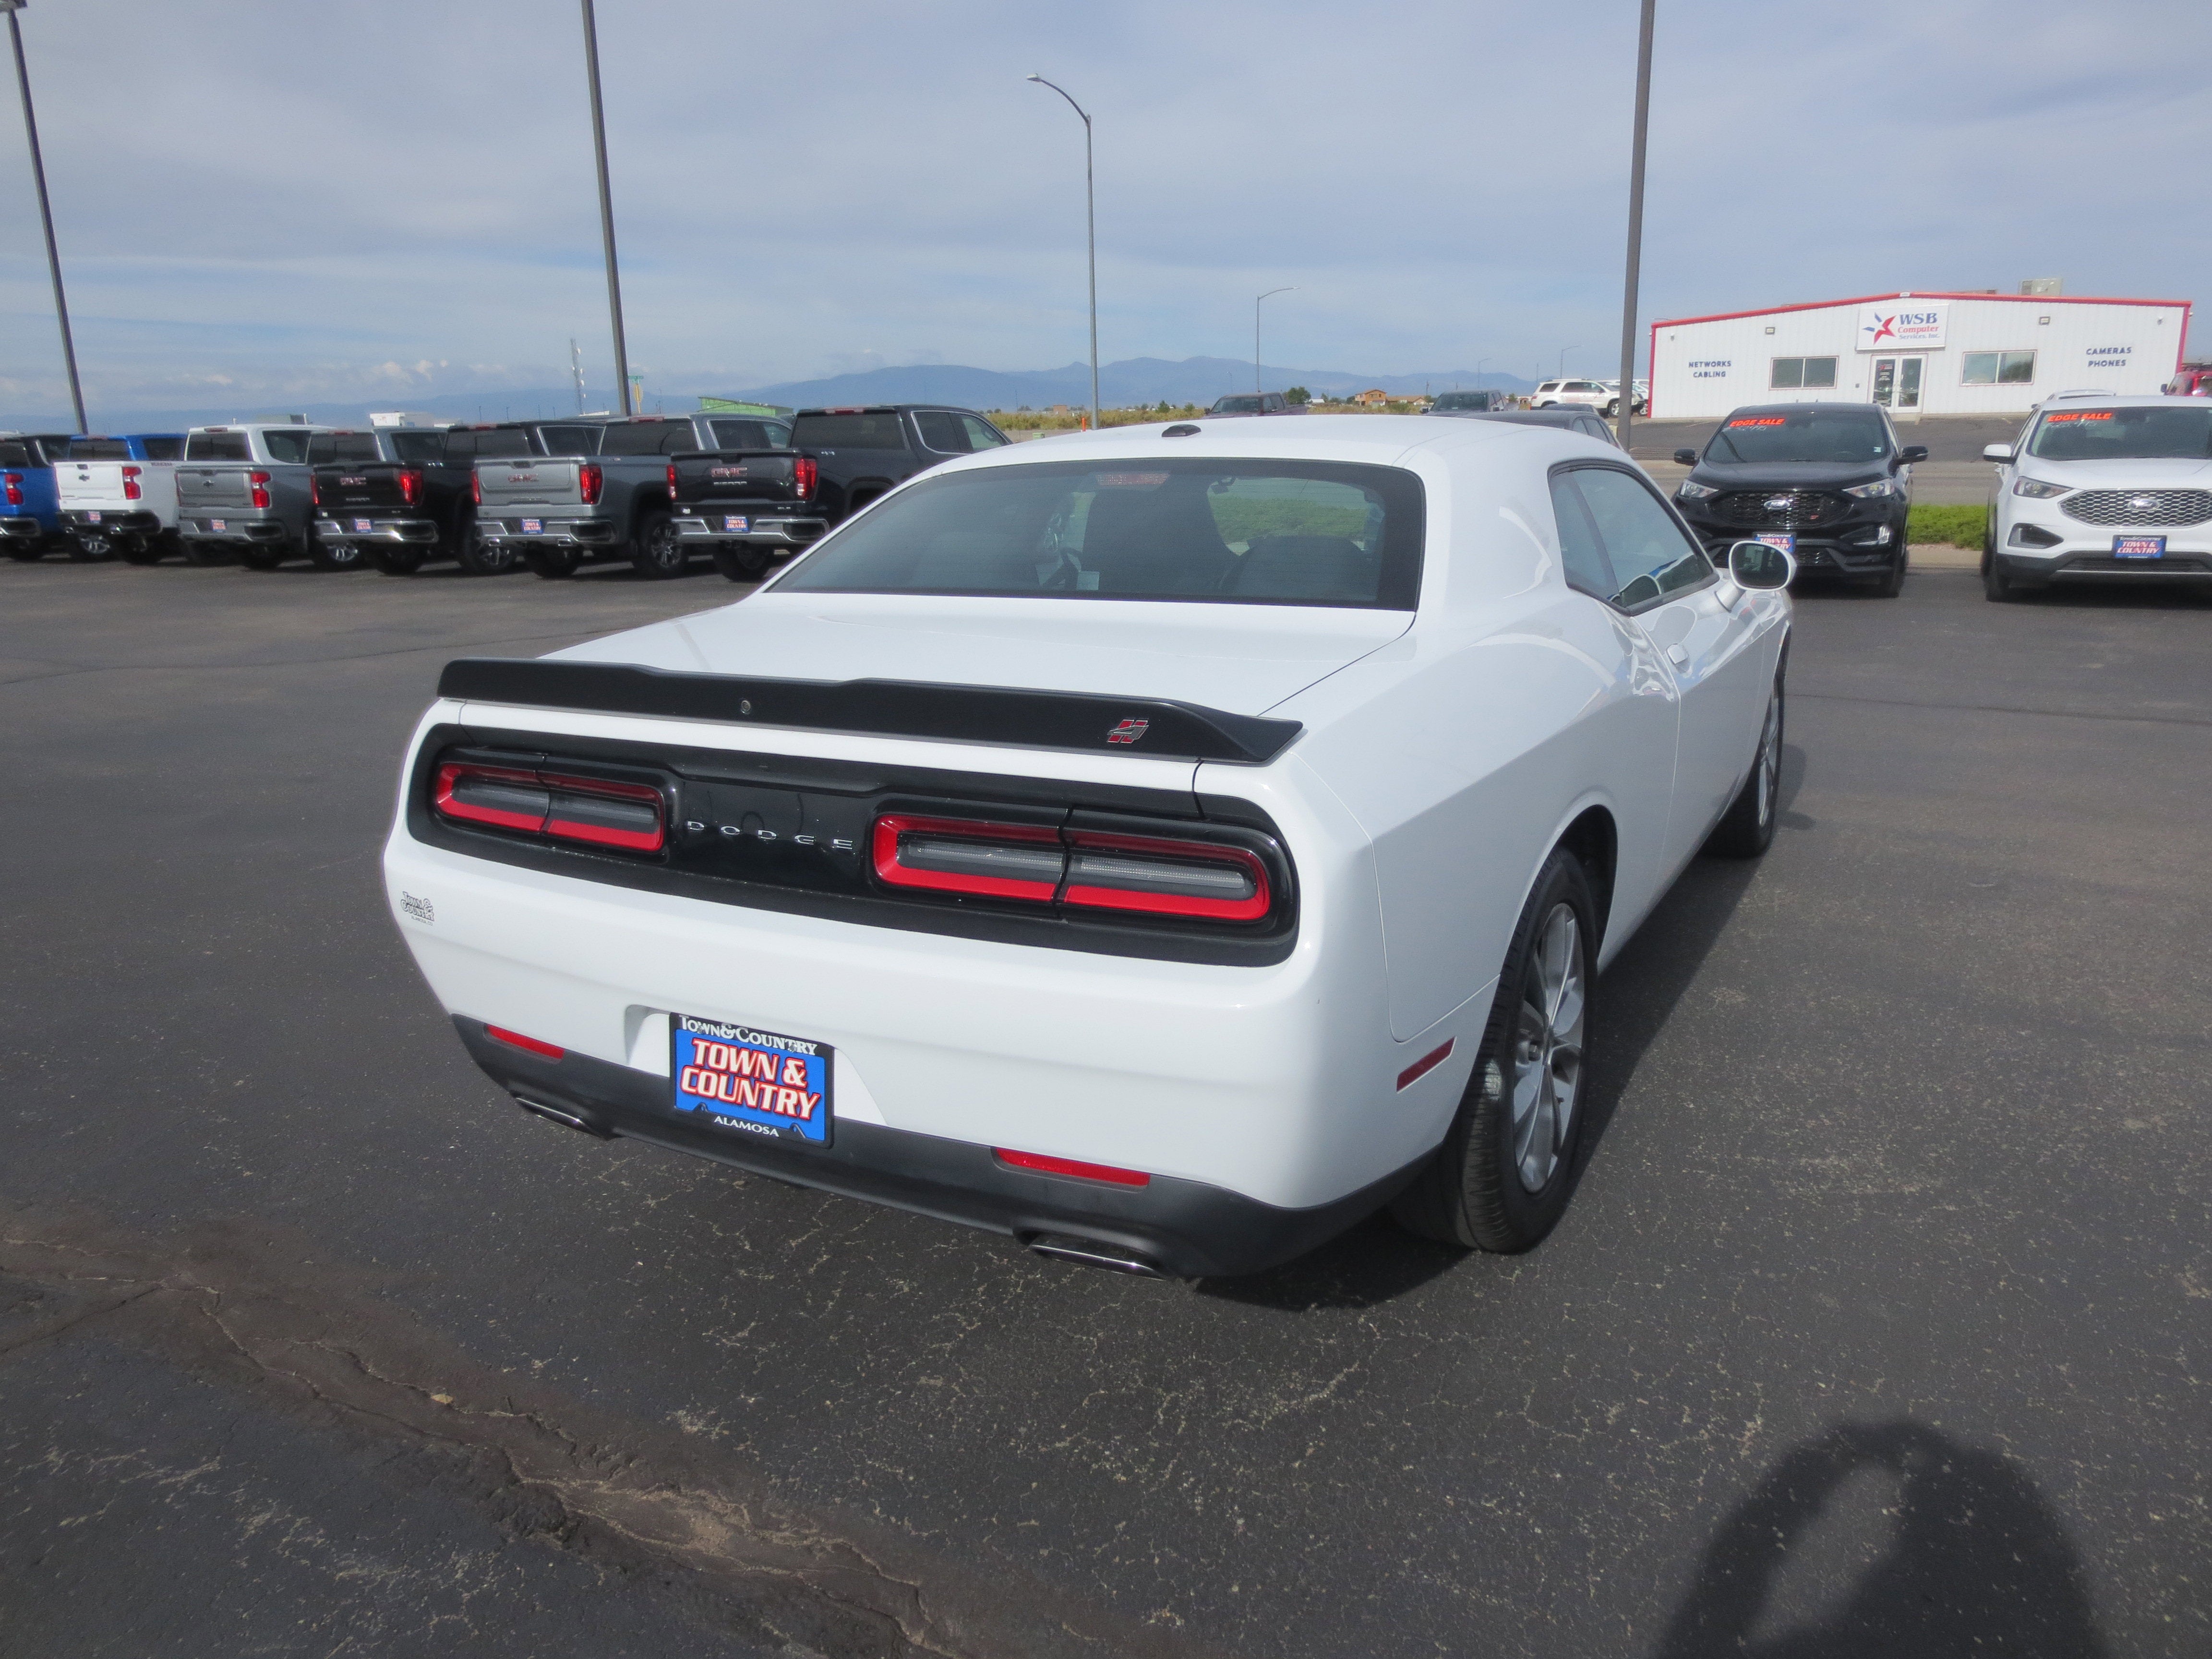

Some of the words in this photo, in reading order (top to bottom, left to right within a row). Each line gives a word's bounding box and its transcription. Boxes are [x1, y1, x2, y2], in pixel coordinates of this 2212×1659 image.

[1899, 313, 1937, 325] WSB
[1898, 326, 1940, 335] Computer
[2086, 347, 2132, 355] CAMERAS
[2088, 359, 2127, 367] PHONES
[2047, 414, 2080, 422] EDGE
[711, 467, 747, 478] GMC
[687, 821, 853, 850] DODGE
[692, 1037, 780, 1082] TOWN
[782, 1057, 807, 1088] &
[680, 1065, 821, 1120] COUNTRY
[714, 1115, 780, 1137] ALAMOSA
